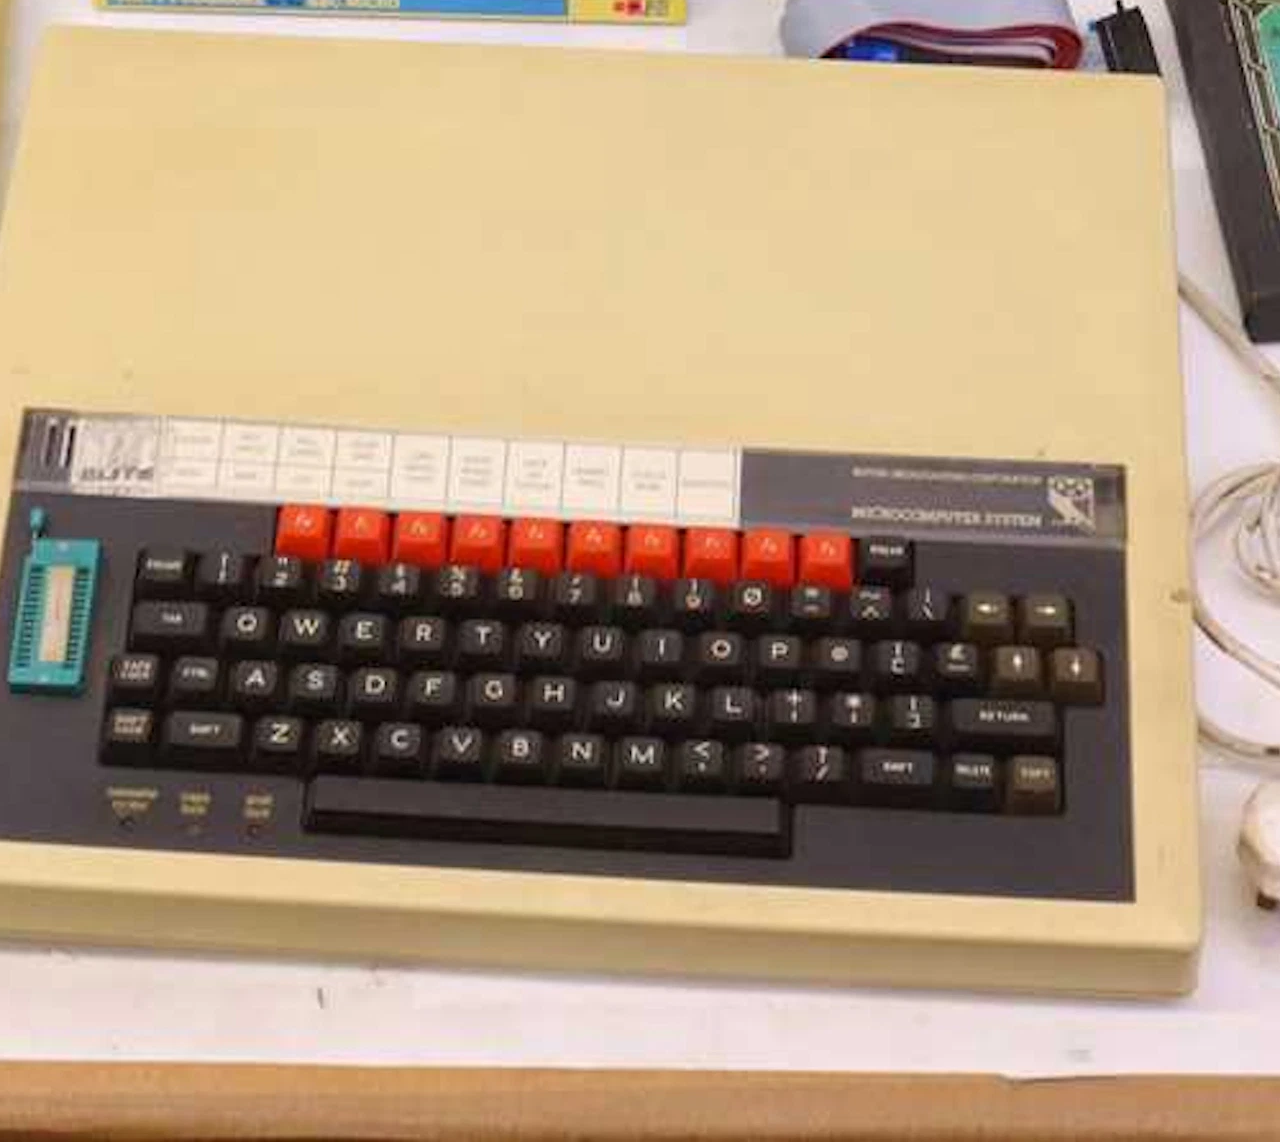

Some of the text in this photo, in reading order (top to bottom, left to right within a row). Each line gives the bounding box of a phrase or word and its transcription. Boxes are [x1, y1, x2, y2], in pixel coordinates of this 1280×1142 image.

[851, 506, 1043, 528] MICROCOMPUTER SYSTEM
[275, 572, 286, 585] 2
[334, 576, 347, 591] 3
[238, 614, 257, 631] Q
[295, 619, 319, 634] W
[357, 622, 372, 638] E
[417, 624, 431, 640] R
[477, 627, 490, 644] T
[535, 632, 550, 648] Y
[594, 634, 611, 652] U
[712, 640, 731, 658] O
[772, 643, 787, 658] P
[246, 670, 264, 685] A
[308, 671, 323, 689] S
[366, 675, 385, 693] D
[426, 678, 441, 694] F
[486, 681, 503, 699] G
[545, 685, 564, 701] H
[608, 690, 624, 706] J
[666, 692, 682, 709] K
[726, 695, 741, 712] L
[980, 711, 1028, 721] RETURN
[271, 724, 289, 742] Z
[332, 727, 348, 744] X
[392, 730, 407, 748] C
[453, 736, 471, 752] V
[513, 738, 528, 756] B
[573, 742, 591, 759] N
[632, 746, 654, 763] M
